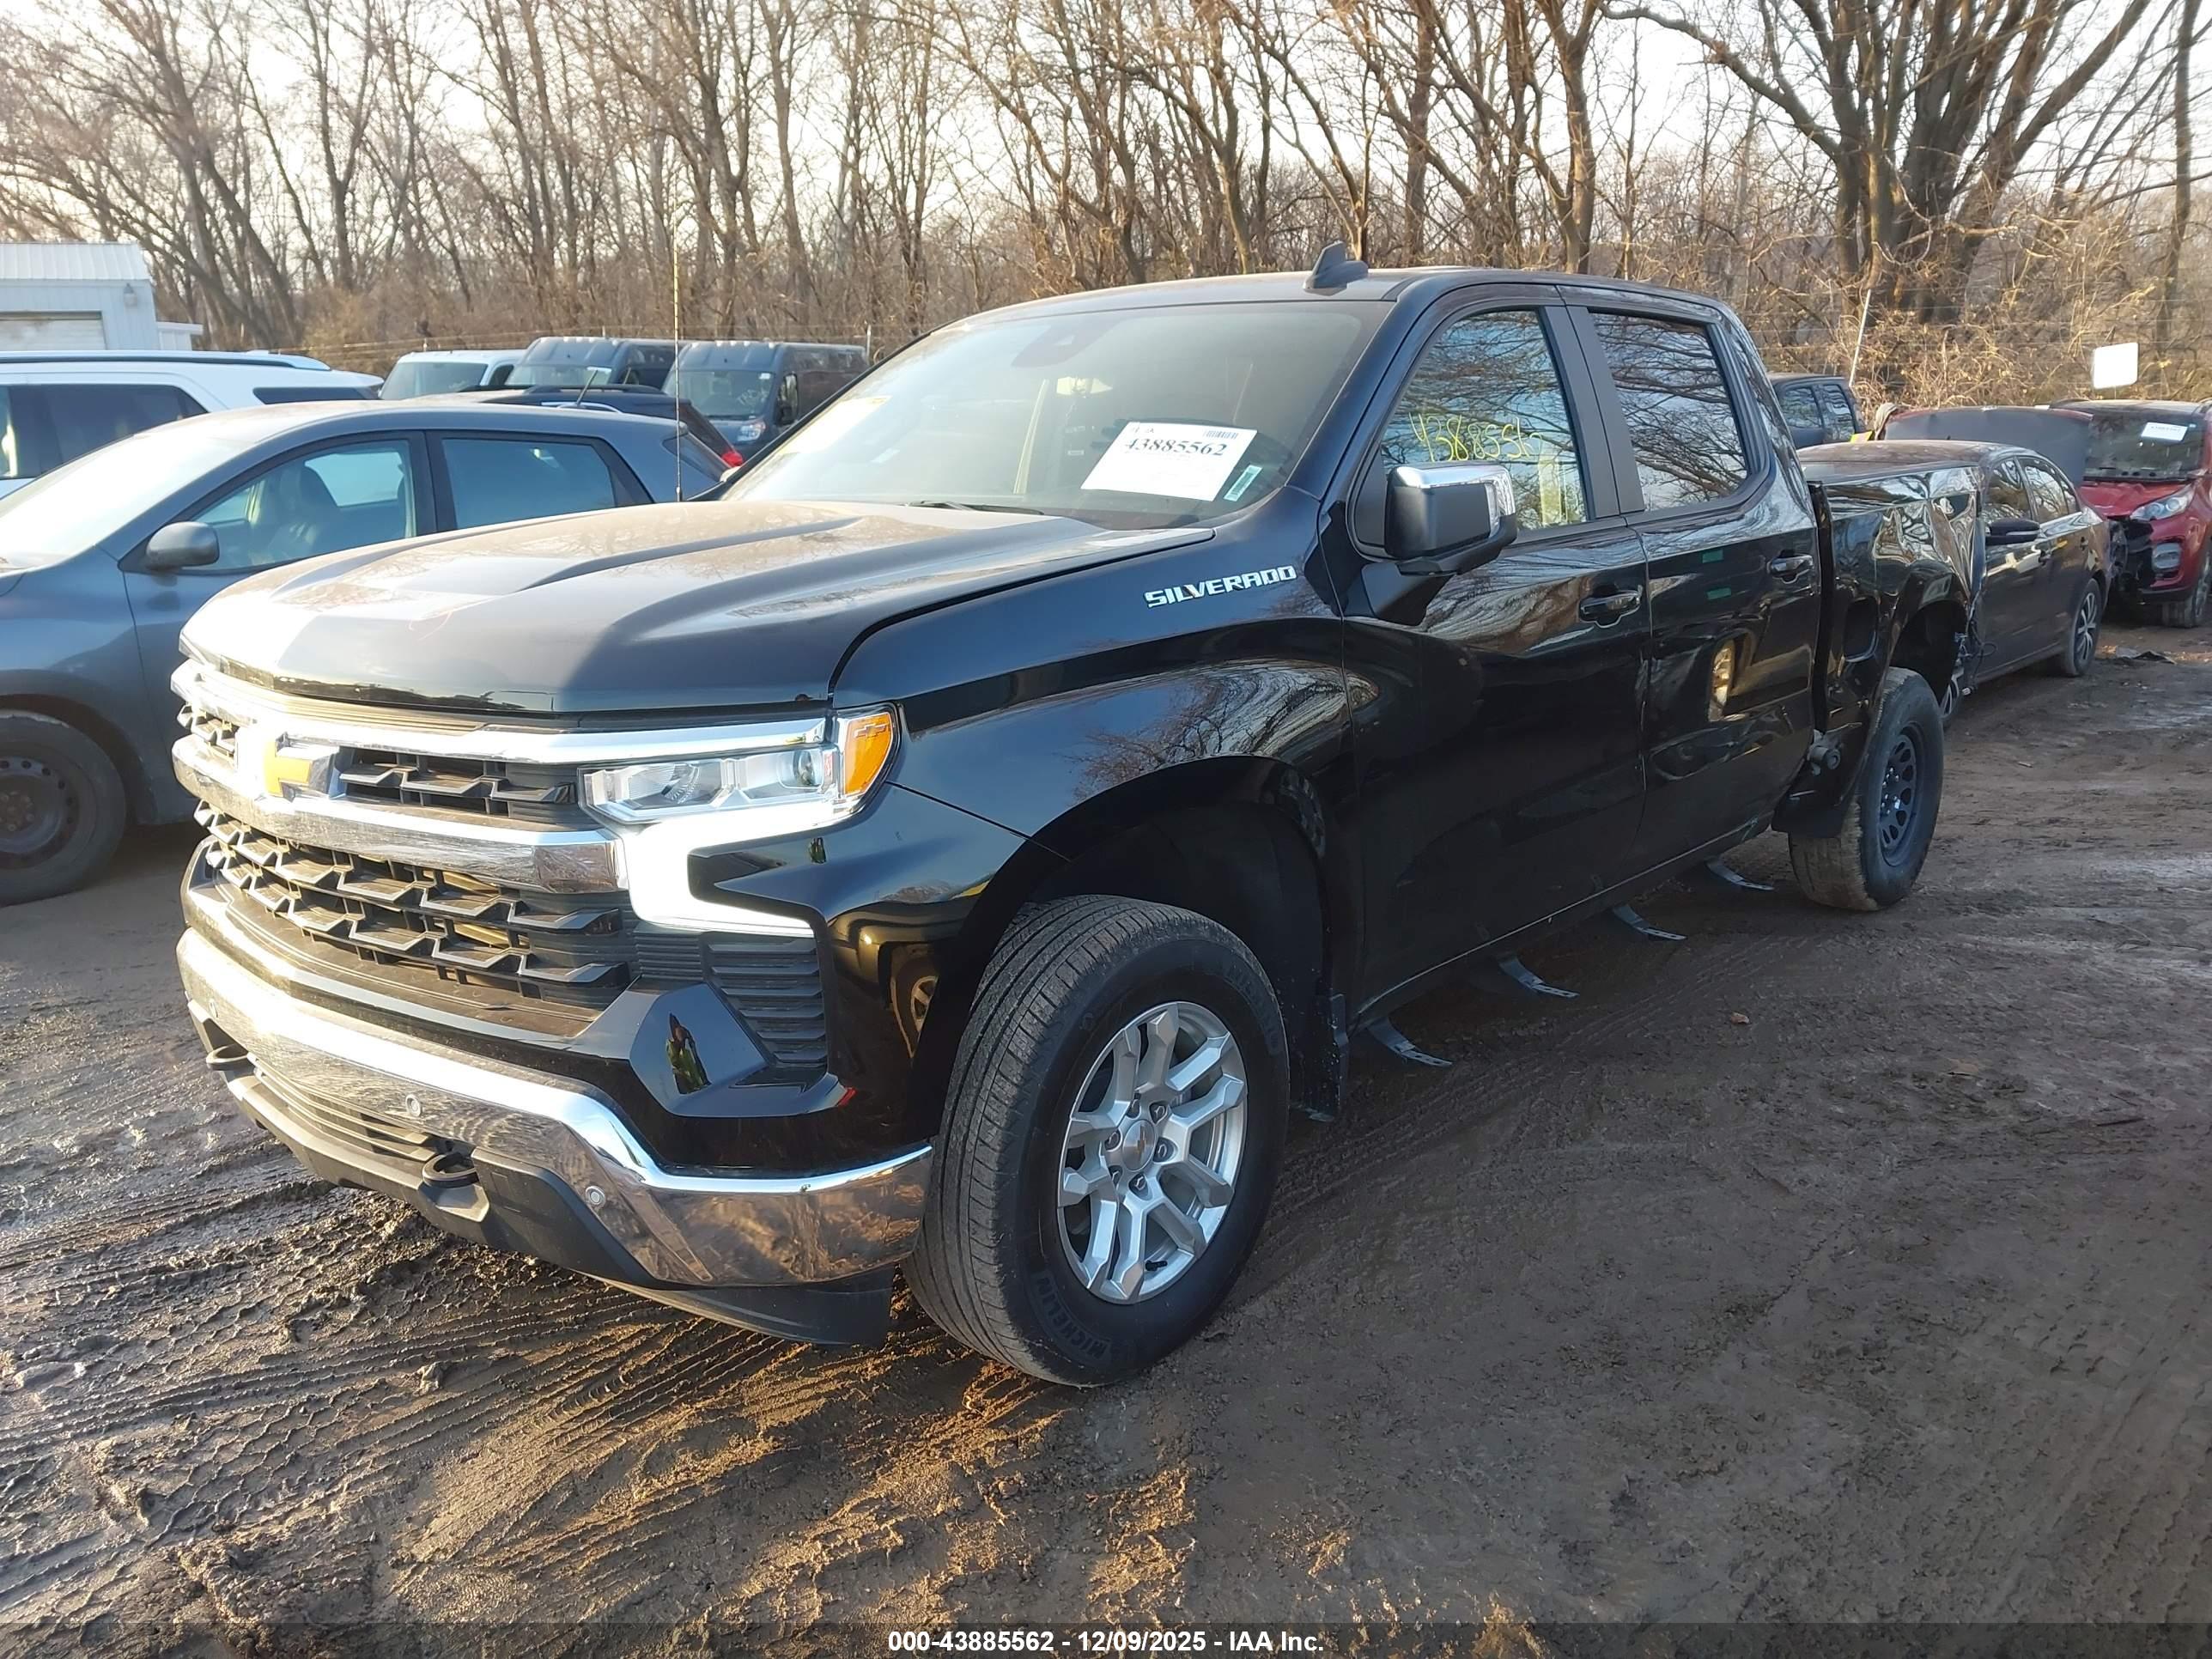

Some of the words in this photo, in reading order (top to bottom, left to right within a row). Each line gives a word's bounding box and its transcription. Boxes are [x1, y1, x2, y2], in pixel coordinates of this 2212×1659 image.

[1124, 438, 1228, 457] 43885562
[1144, 565, 1298, 608] SILVERADO
[1036, 1276, 1109, 1359] MICHELIN
